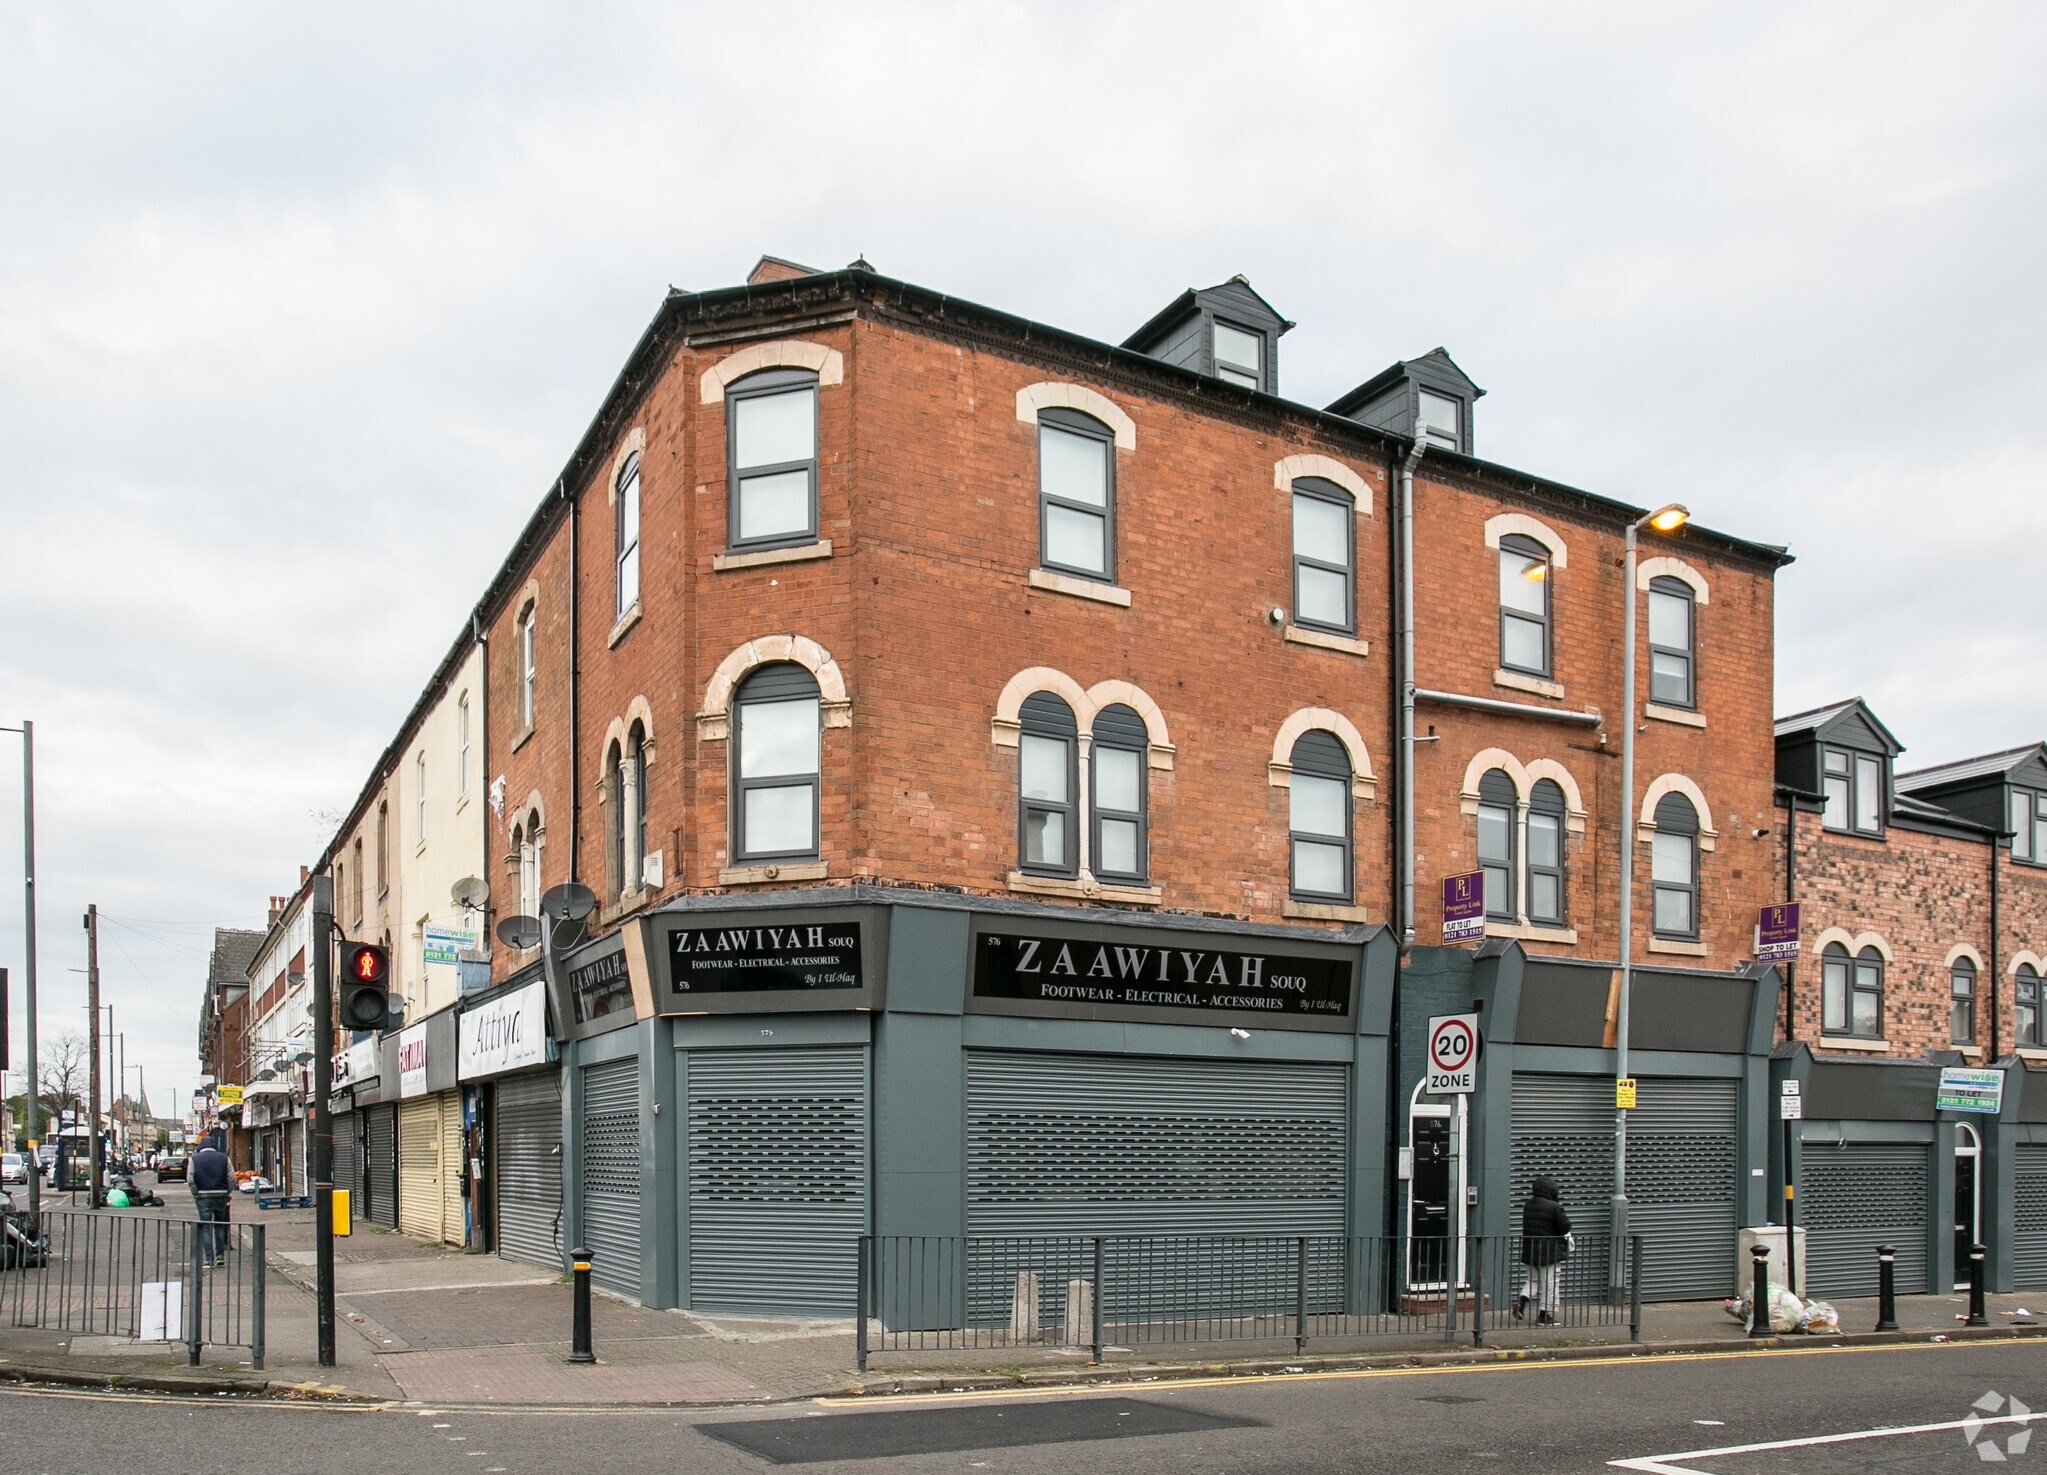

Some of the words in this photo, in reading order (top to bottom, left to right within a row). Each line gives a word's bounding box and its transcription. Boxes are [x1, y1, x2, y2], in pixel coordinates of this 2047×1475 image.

[1468, 900, 1481, 908] Link
[425, 924, 474, 938] homewise
[1446, 922, 1456, 931] FLAT
[1457, 921, 1463, 929] TO
[1463, 920, 1471, 928] LET
[676, 926, 824, 953] ZAAWIYAH
[828, 936, 854, 949] SOUQ
[988, 937, 1001, 946] 576
[1758, 945, 1774, 953] SHOP
[444, 952, 456, 960] 772
[1015, 939, 1265, 988] ZAAWIYAH
[1270, 975, 1307, 993] SOUQ
[570, 954, 620, 993] ZAAWIYAH
[804, 974, 816, 986] By
[824, 972, 855, 985] Ul-Haq
[679, 981, 690, 990] 576
[1299, 999, 1310, 1011] By
[1316, 1000, 1342, 1012] Ul-Haq
[472, 1004, 520, 1065] Attiya
[1438, 1034, 1468, 1056] 20
[1431, 1074, 1470, 1088] ZONE
[1943, 1071, 1999, 1082] homewise
